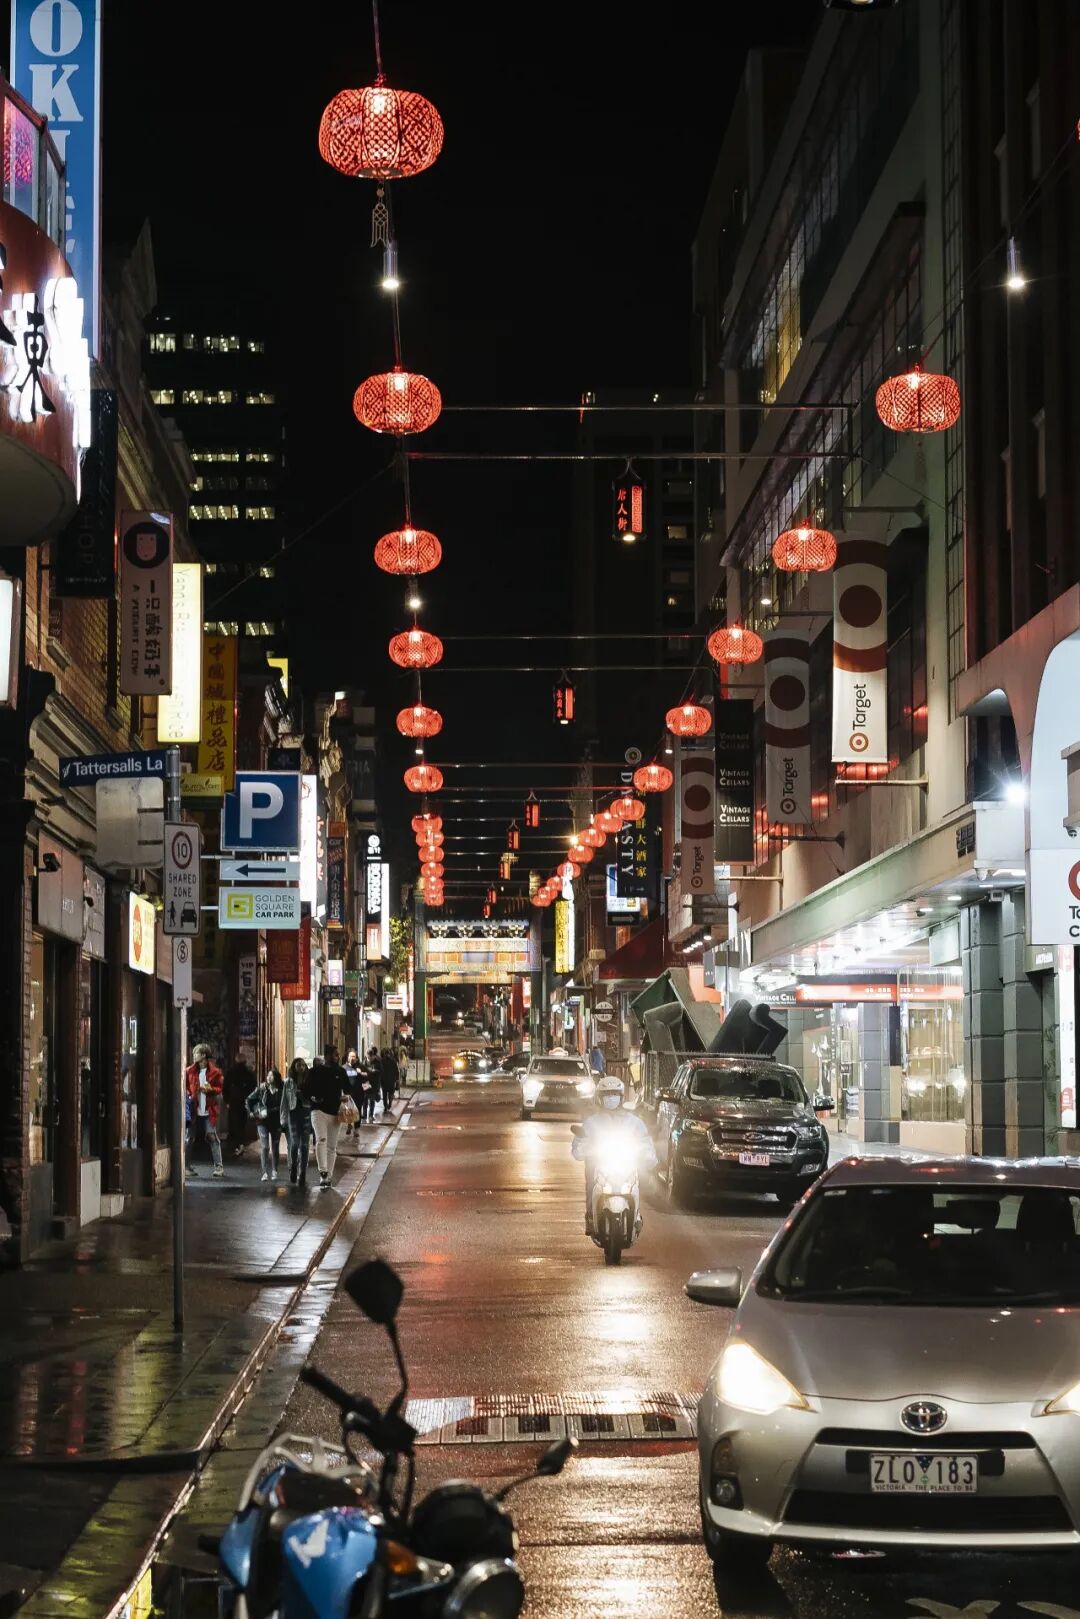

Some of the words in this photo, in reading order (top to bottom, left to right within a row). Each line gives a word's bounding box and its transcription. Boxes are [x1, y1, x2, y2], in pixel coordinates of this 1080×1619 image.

[852, 683, 871, 730] Target
[72, 760, 143, 777] Tattersalls
[146, 757, 164, 772] La
[719, 768, 750, 777] VINTAGE
[719, 777, 750, 786] CELLARS
[782, 757, 801, 796] Target
[239, 781, 284, 839] P
[720, 804, 751, 814] VINTAGE
[620, 771, 634, 876] DYASTY
[719, 813, 751, 823] CELLARS
[176, 842, 188, 859] 10
[692, 846, 707, 876] Target
[168, 872, 197, 884] SHARED
[173, 886, 193, 898] ZONE
[255, 895, 295, 903] GOLDEN
[255, 903, 295, 911] SQUARE
[255, 911, 271, 919] CAR
[273, 911, 295, 919] PARK
[936, 1460, 974, 1485] 183
